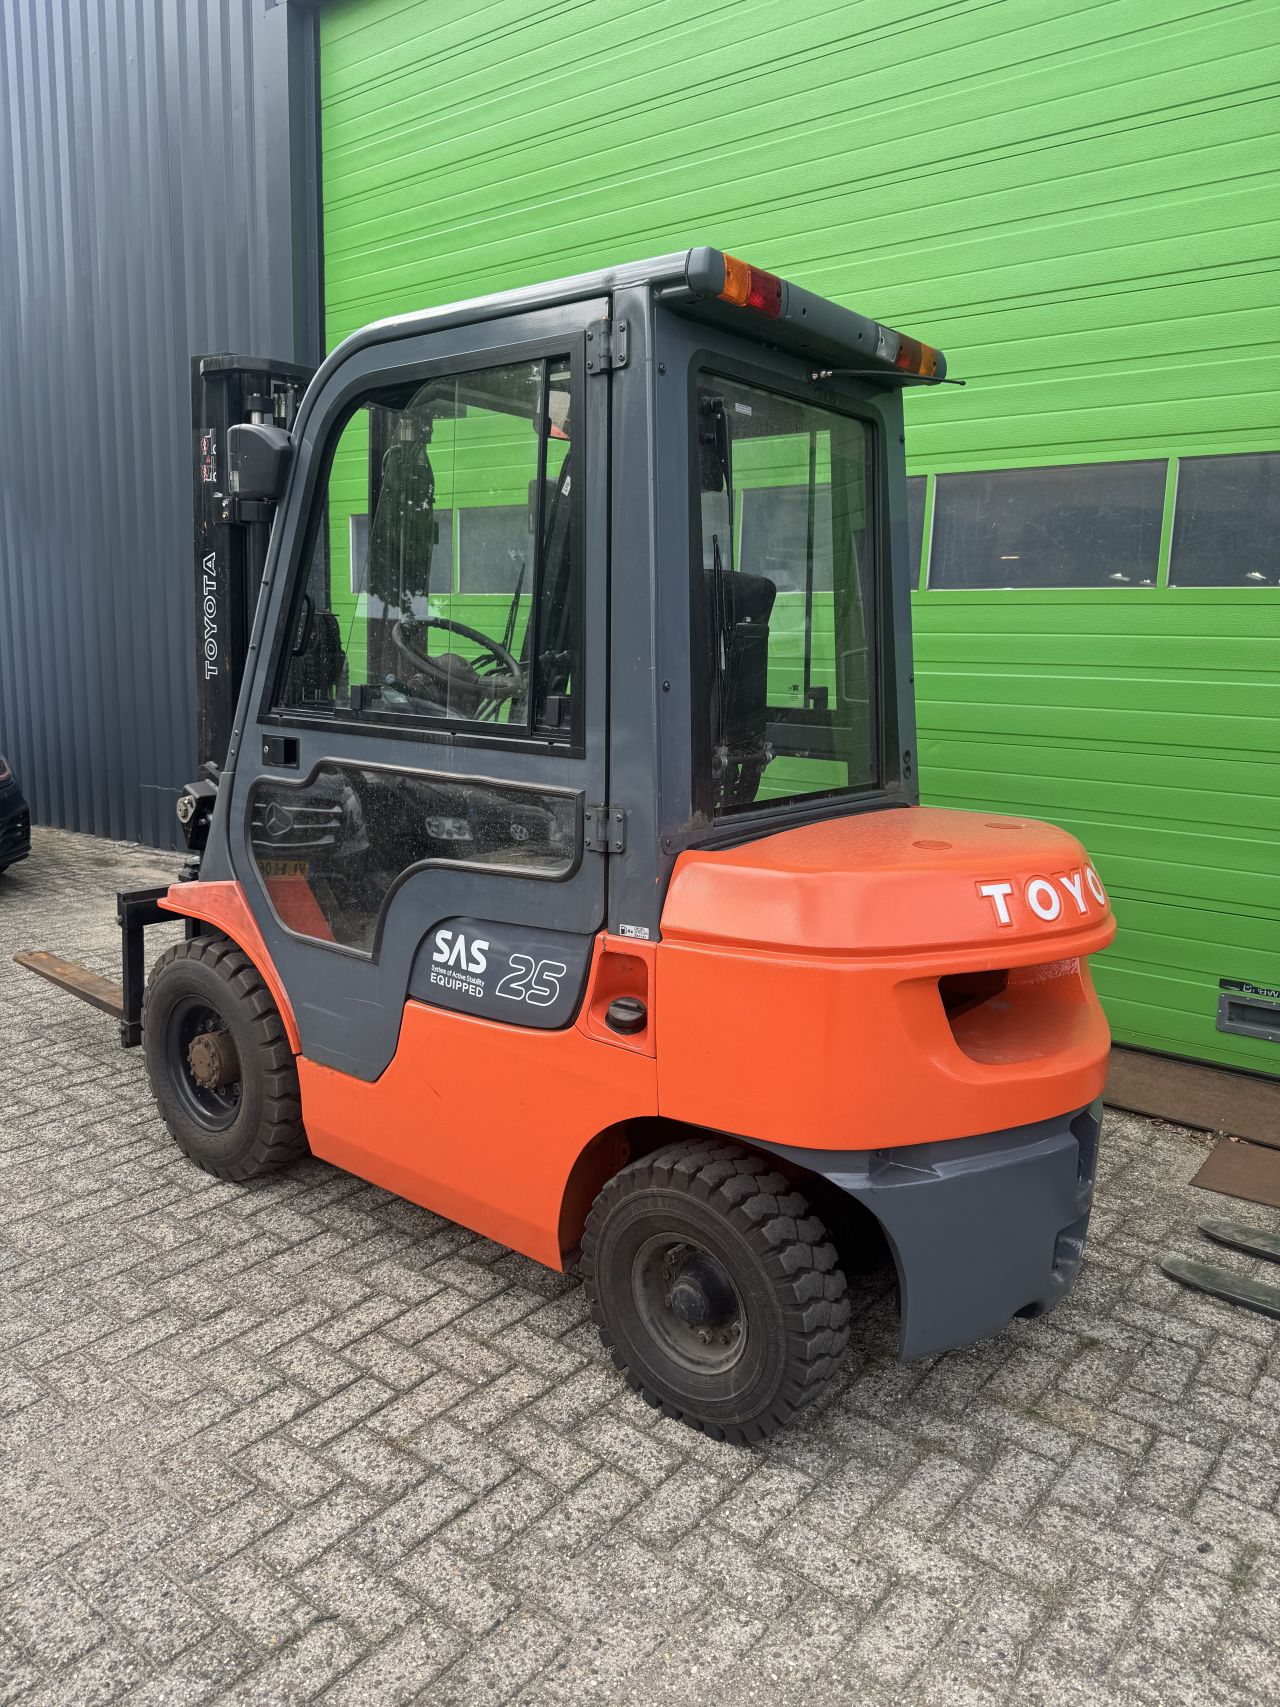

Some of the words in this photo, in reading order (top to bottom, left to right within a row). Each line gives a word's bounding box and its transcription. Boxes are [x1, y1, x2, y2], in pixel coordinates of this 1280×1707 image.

[203, 552, 218, 680] TOYOTA
[432, 929, 490, 974] SAS
[430, 972, 484, 998] EQUIPPED
[431, 964, 447, 975] System
[452, 971, 468, 981] Active
[466, 975, 485, 988] Stability
[495, 953, 567, 1007] 25
